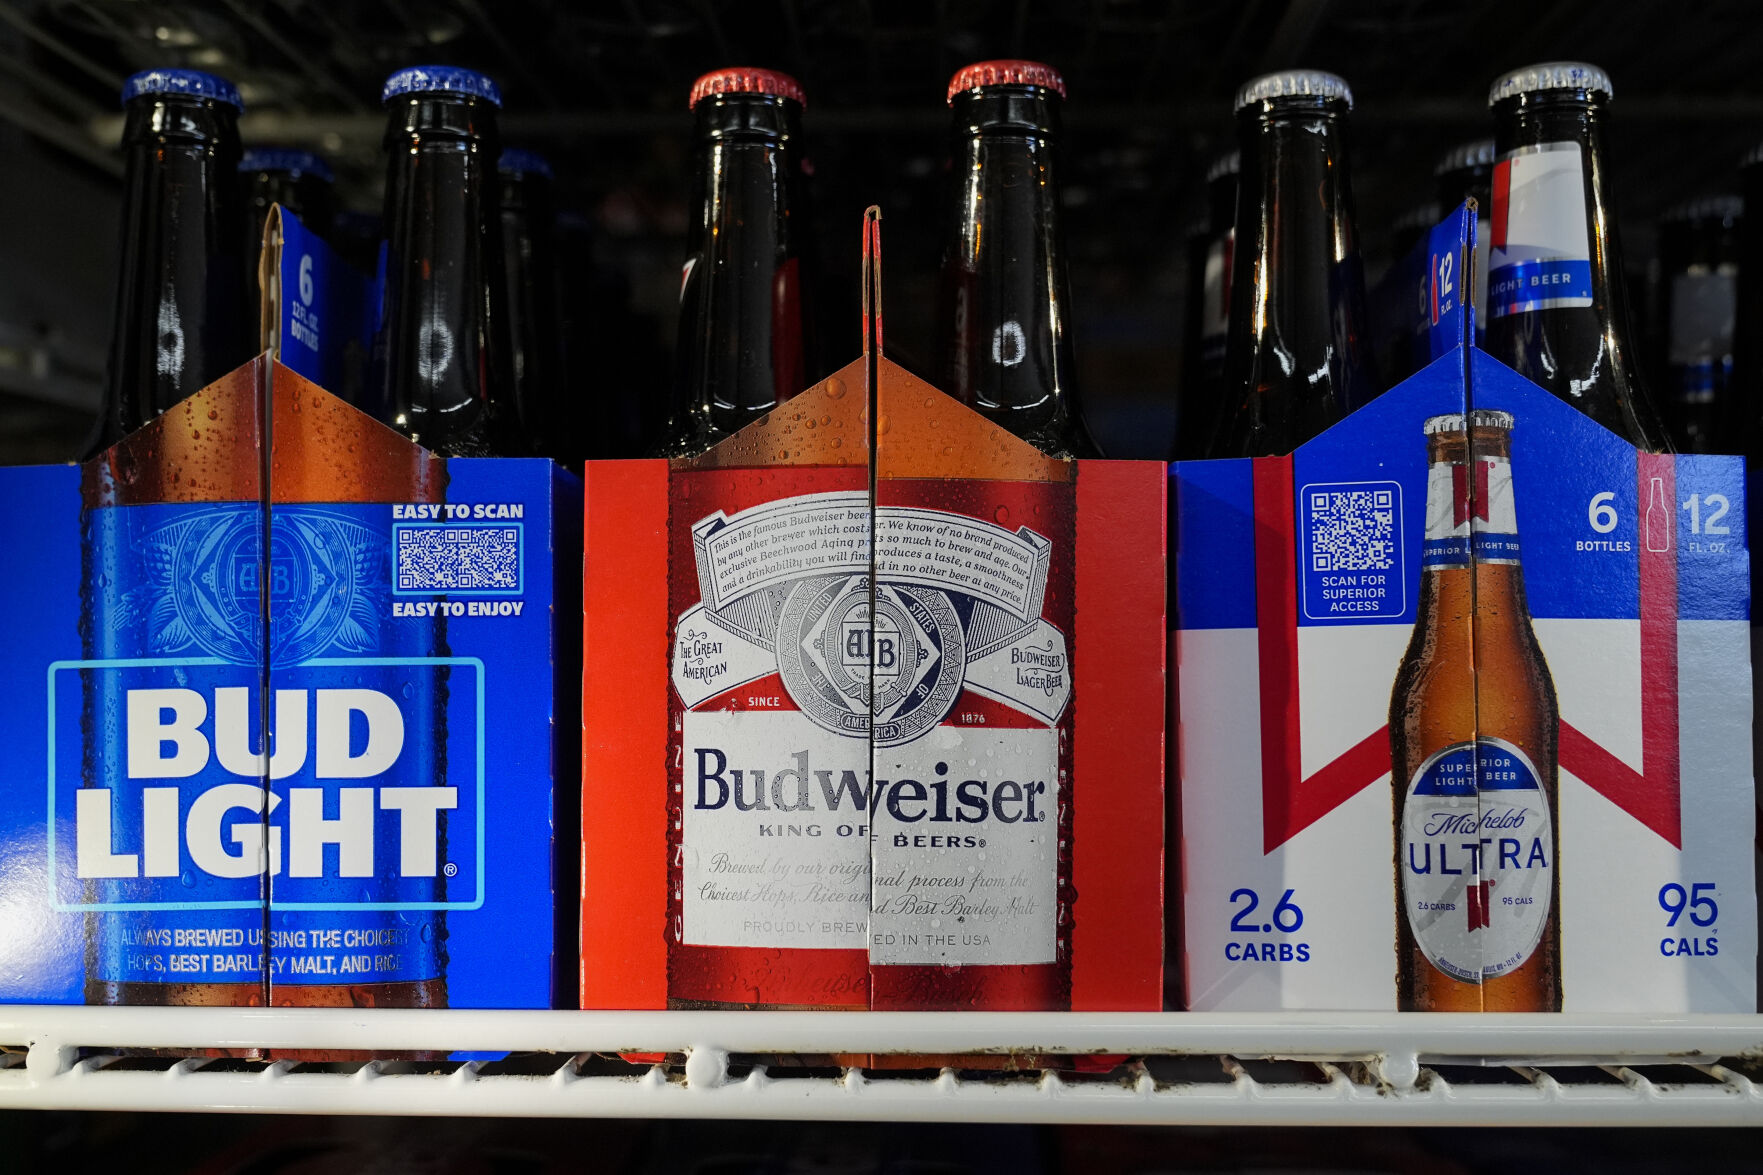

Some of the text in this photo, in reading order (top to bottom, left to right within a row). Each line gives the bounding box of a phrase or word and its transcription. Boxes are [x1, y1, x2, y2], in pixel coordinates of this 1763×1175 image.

[299, 254, 313, 307] 6
[1439, 251, 1453, 297] 12
[1531, 273, 1571, 286] BEER
[291, 318, 319, 352] BOTTLES
[392, 504, 523, 519] EASY TO SCAN
[1588, 491, 1730, 534] 6 12
[713, 541, 730, 554] This
[730, 535, 738, 546] is
[738, 530, 752, 543] the
[753, 520, 787, 538] famous
[789, 511, 845, 526] Budweiser
[888, 520, 904, 530] We
[906, 519, 934, 534] know
[937, 525, 950, 538] of
[950, 529, 962, 539] no
[964, 530, 992, 548] brand
[993, 540, 1030, 565] produced
[717, 555, 727, 567] by
[728, 548, 744, 562] any
[745, 538, 769, 552] other
[771, 530, 806, 543] brewer
[808, 523, 840, 536] which
[887, 535, 900, 543] so
[902, 535, 932, 547] much
[934, 538, 946, 549] to
[948, 540, 974, 555] brew
[974, 547, 992, 561] and
[993, 556, 1010, 570] age.
[1576, 540, 1730, 553] BOTTLES FL. OZ.
[719, 557, 758, 580] exclusive
[759, 540, 818, 561] Beechwood
[821, 538, 854, 552] Aging
[924, 552, 932, 561] a
[934, 552, 963, 568] taste,
[965, 560, 972, 569] a
[973, 563, 1025, 590] smoothness
[722, 579, 738, 593] and
[738, 576, 745, 585] a
[746, 558, 803, 581] drinkability
[805, 554, 825, 567] you
[827, 551, 848, 562] will
[888, 560, 900, 571] in
[902, 563, 916, 572] no
[918, 564, 947, 577] other
[948, 566, 971, 583] beer
[972, 576, 982, 586] at
[983, 580, 1000, 595] any
[1001, 588, 1022, 605] price.
[1322, 575, 1386, 587] SCAN FOR
[1322, 587, 1386, 600] SUPERIOR
[393, 602, 524, 617] EASY TO ENJOY
[808, 592, 833, 622] UNITED
[1330, 601, 1380, 612] ACCESS
[909, 602, 936, 634] STATES
[915, 683, 929, 699] OF
[748, 697, 780, 707] SINCE
[961, 713, 985, 724] 1876
[127, 687, 404, 780] BUD
[1440, 759, 1511, 773] SUPERIOR
[1435, 771, 1516, 786] LIGHT BEER
[1424, 808, 1528, 836] Michelob
[759, 824, 822, 837] KING
[836, 824, 878, 842] OF
[1409, 837, 1547, 875] ULTRA
[709, 853, 767, 875] Brewed
[771, 858, 790, 882] by
[795, 864, 825, 875] our
[907, 874, 965, 892] process
[969, 870, 1006, 893] from
[1009, 872, 1028, 888] the
[698, 881, 752, 902] Choicest
[892, 894, 940, 915] Best
[941, 895, 999, 921] Barley
[1229, 888, 1304, 933] 2.6
[1430, 903, 1456, 911] CARBS
[1502, 897, 1533, 905] 95 CALS
[1658, 883, 1718, 927] 95
[121, 929, 172, 946] ALWAYS
[174, 928, 244, 947] BREWED
[248, 928, 306, 948] USING
[309, 929, 341, 948] THE
[744, 921, 815, 933] PROUDLY
[902, 935, 918, 945] IN
[925, 935, 956, 945] THE
[963, 935, 991, 945] USA
[1224, 942, 1310, 962] CARBS
[1660, 937, 1719, 957] CALS
[170, 954, 210, 972] BEST
[213, 954, 287, 974] BARLEY
[291, 955, 337, 975] MALT,
[340, 955, 372, 973] AND
